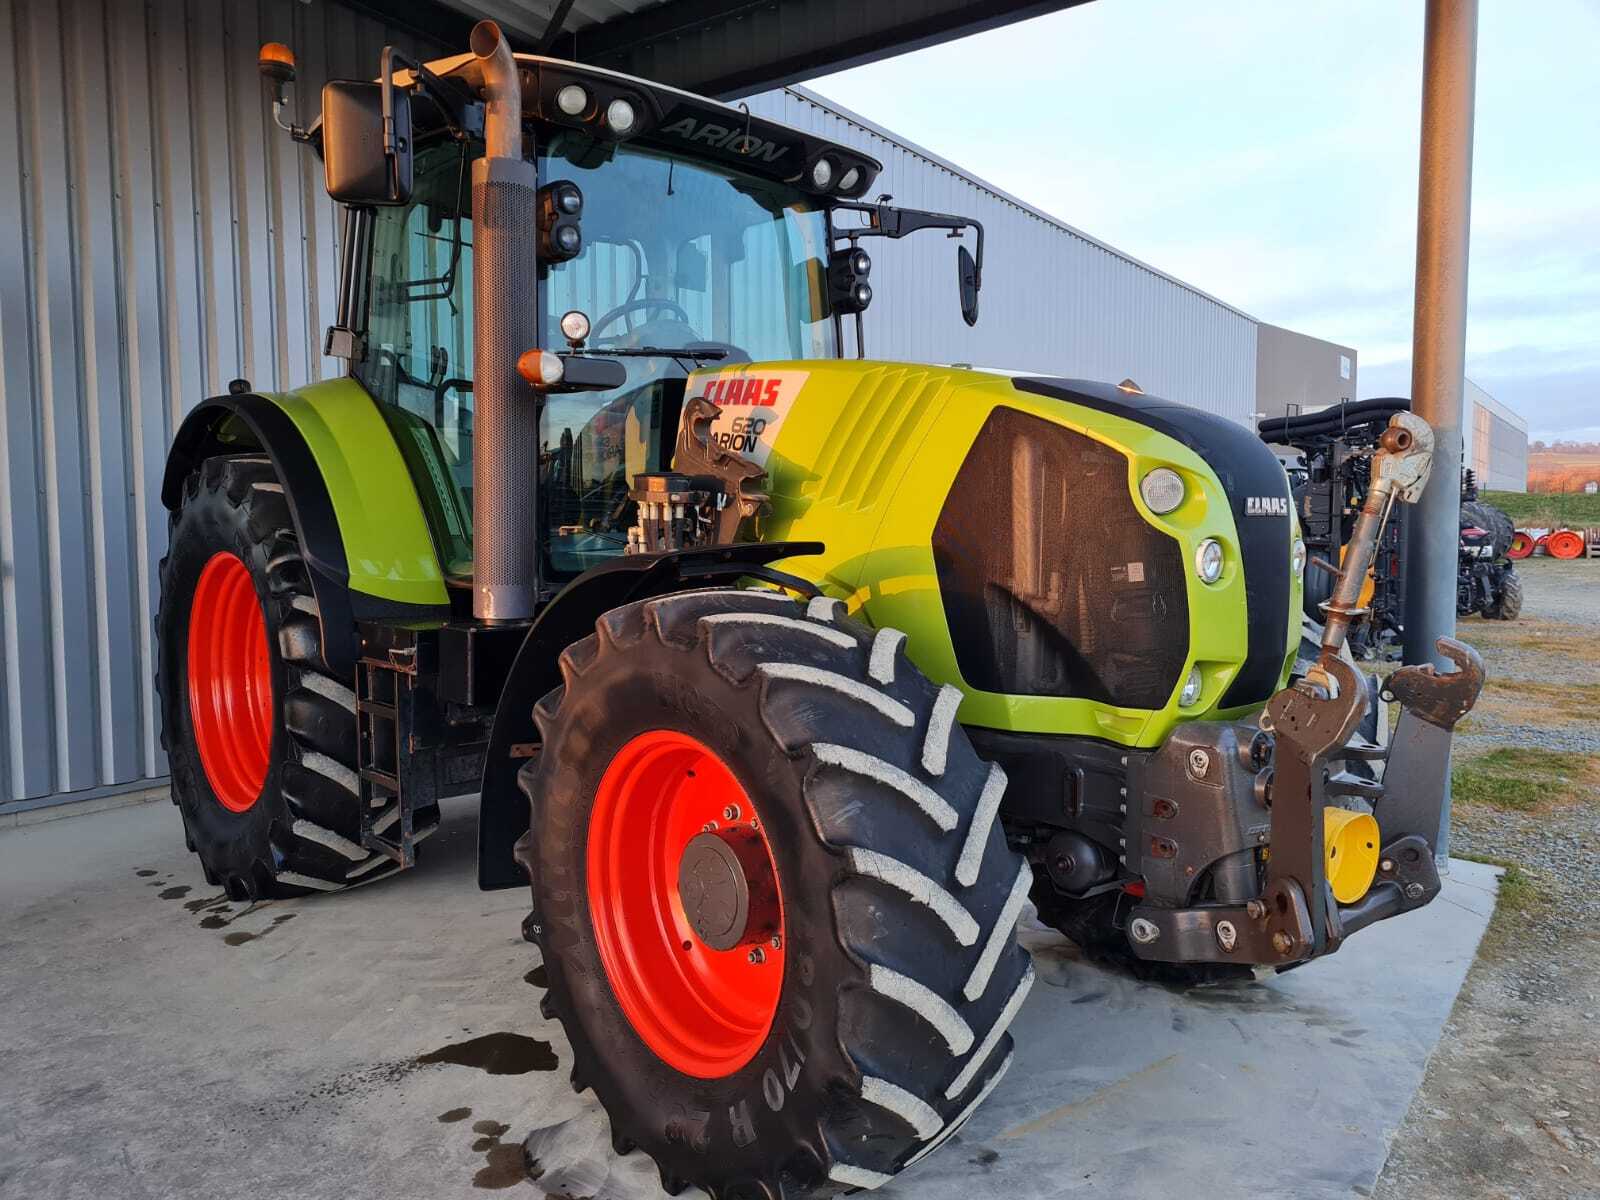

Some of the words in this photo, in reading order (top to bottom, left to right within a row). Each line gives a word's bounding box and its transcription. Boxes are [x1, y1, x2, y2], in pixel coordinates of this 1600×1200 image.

[661, 116, 790, 163] ARION
[704, 379, 782, 406] CLAAS
[731, 416, 767, 435] 620
[1247, 496, 1288, 515] CLAAS
